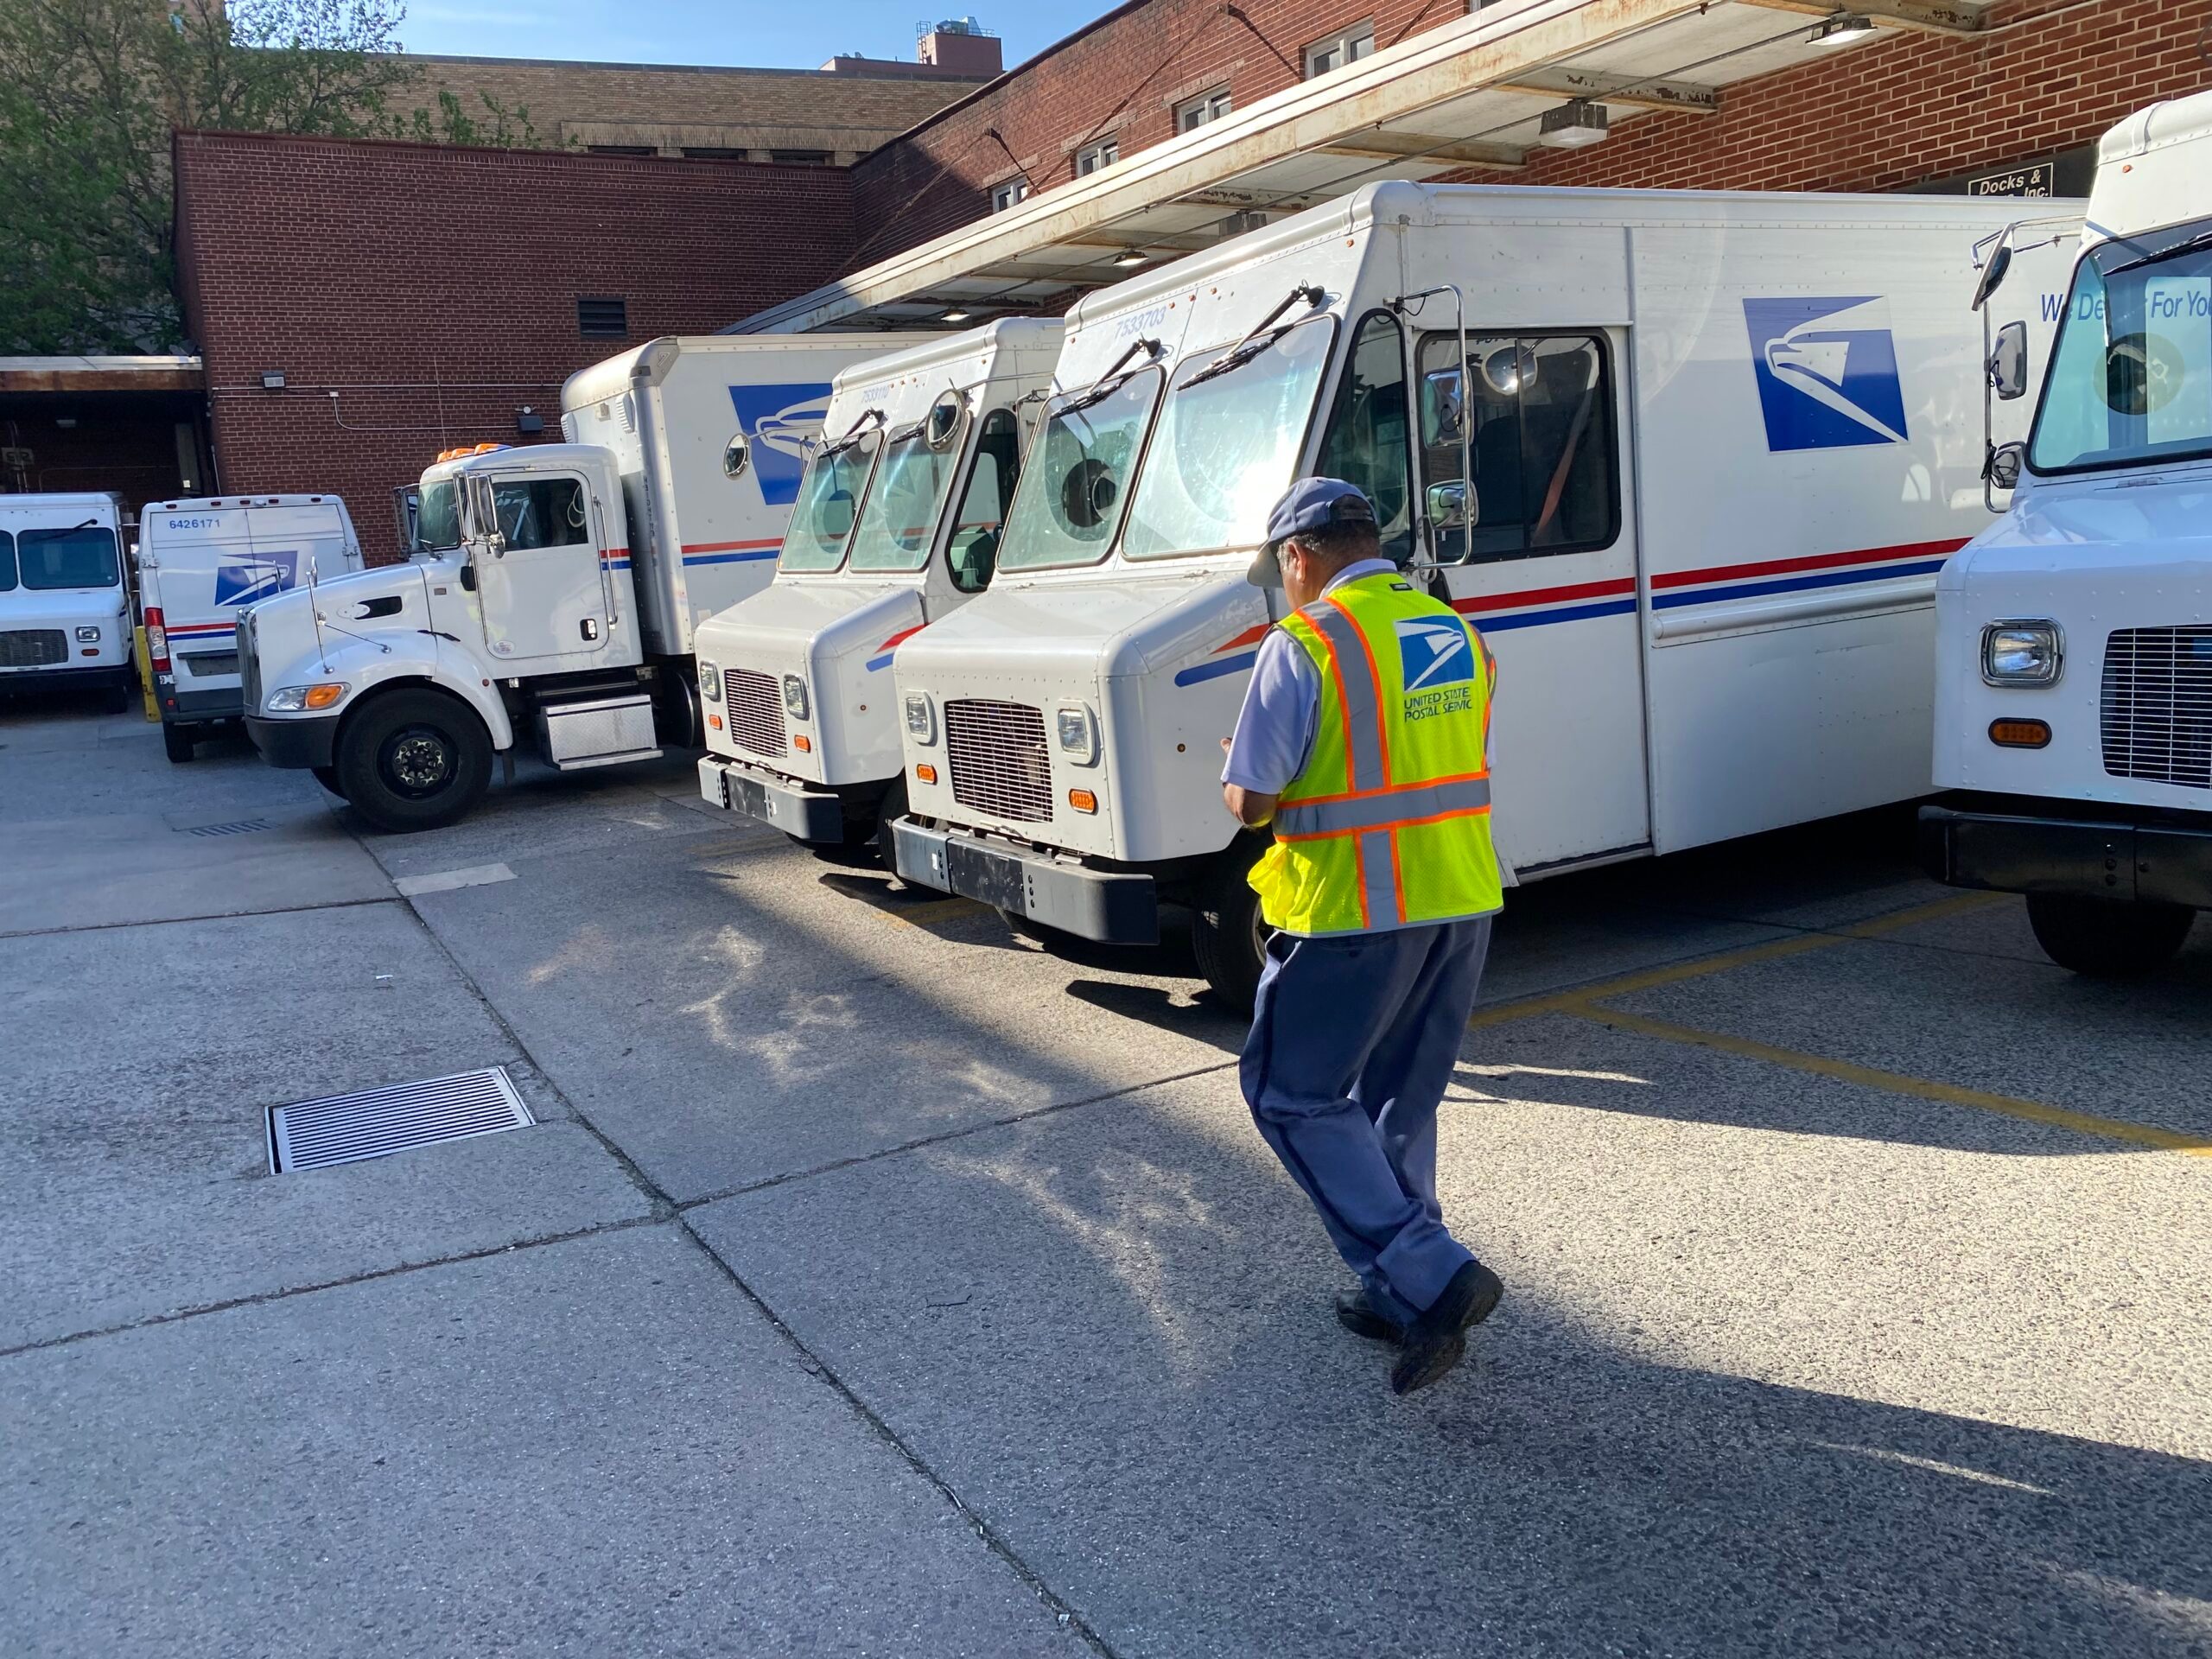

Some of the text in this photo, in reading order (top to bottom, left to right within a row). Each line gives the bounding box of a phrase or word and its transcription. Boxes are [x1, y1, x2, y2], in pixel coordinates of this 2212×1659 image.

[1980, 168, 2041, 195] Docks &
[2151, 291, 2183, 318] For
[1115, 306, 1166, 339] 7533703
[169, 518, 220, 529] 6426171
[1404, 692, 1441, 709] UNITED
[1405, 705, 1440, 722] POSTAL
